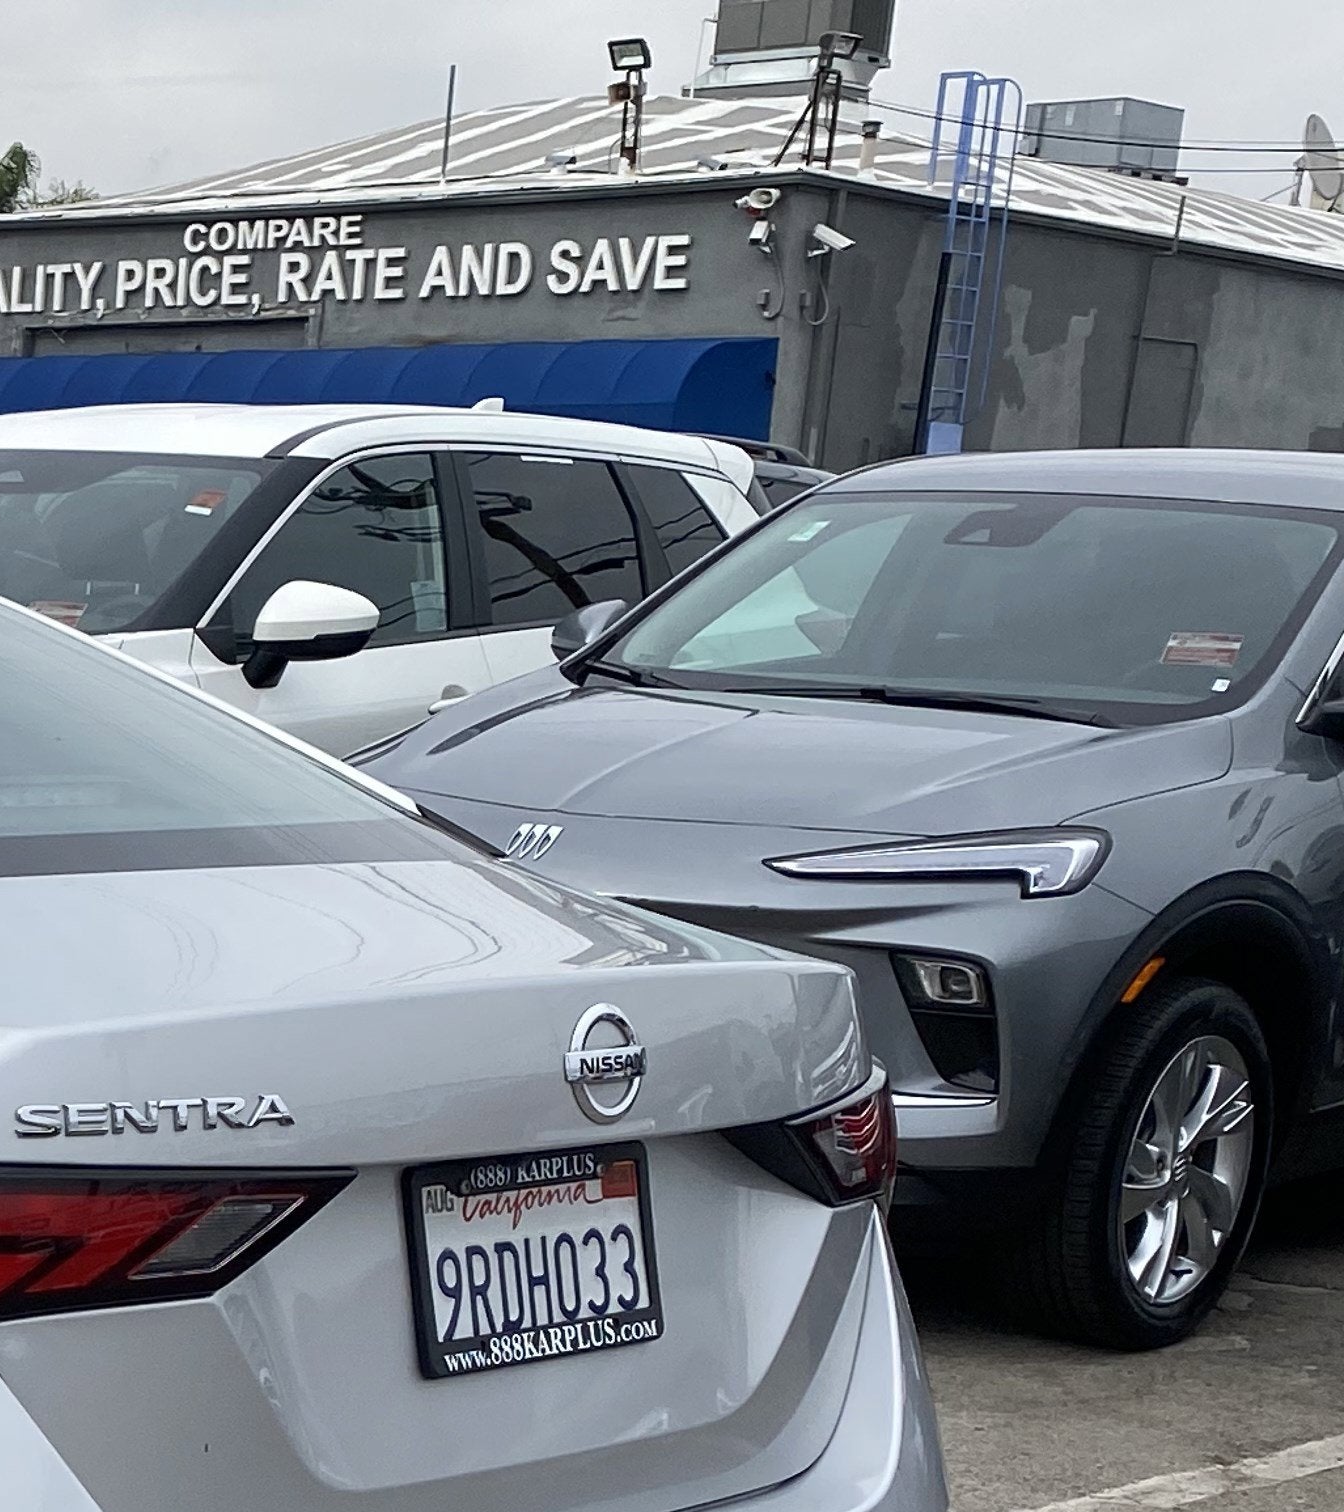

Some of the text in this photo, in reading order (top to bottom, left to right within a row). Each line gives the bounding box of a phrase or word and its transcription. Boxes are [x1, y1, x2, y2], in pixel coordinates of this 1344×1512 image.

[183, 216, 363, 253] COMPARE
[115, 254, 261, 316] PRICE,
[278, 247, 407, 303] RATE
[418, 241, 534, 298] AND
[546, 234, 692, 295] SAVE
[580, 1052, 644, 1075] NISSAN
[14, 1093, 295, 1138] SENTRA
[516, 1153, 596, 1184] KARPLUS
[425, 1188, 454, 1214] AUG
[462, 1181, 604, 1231] California
[436, 1223, 641, 1342] 9RDH033
